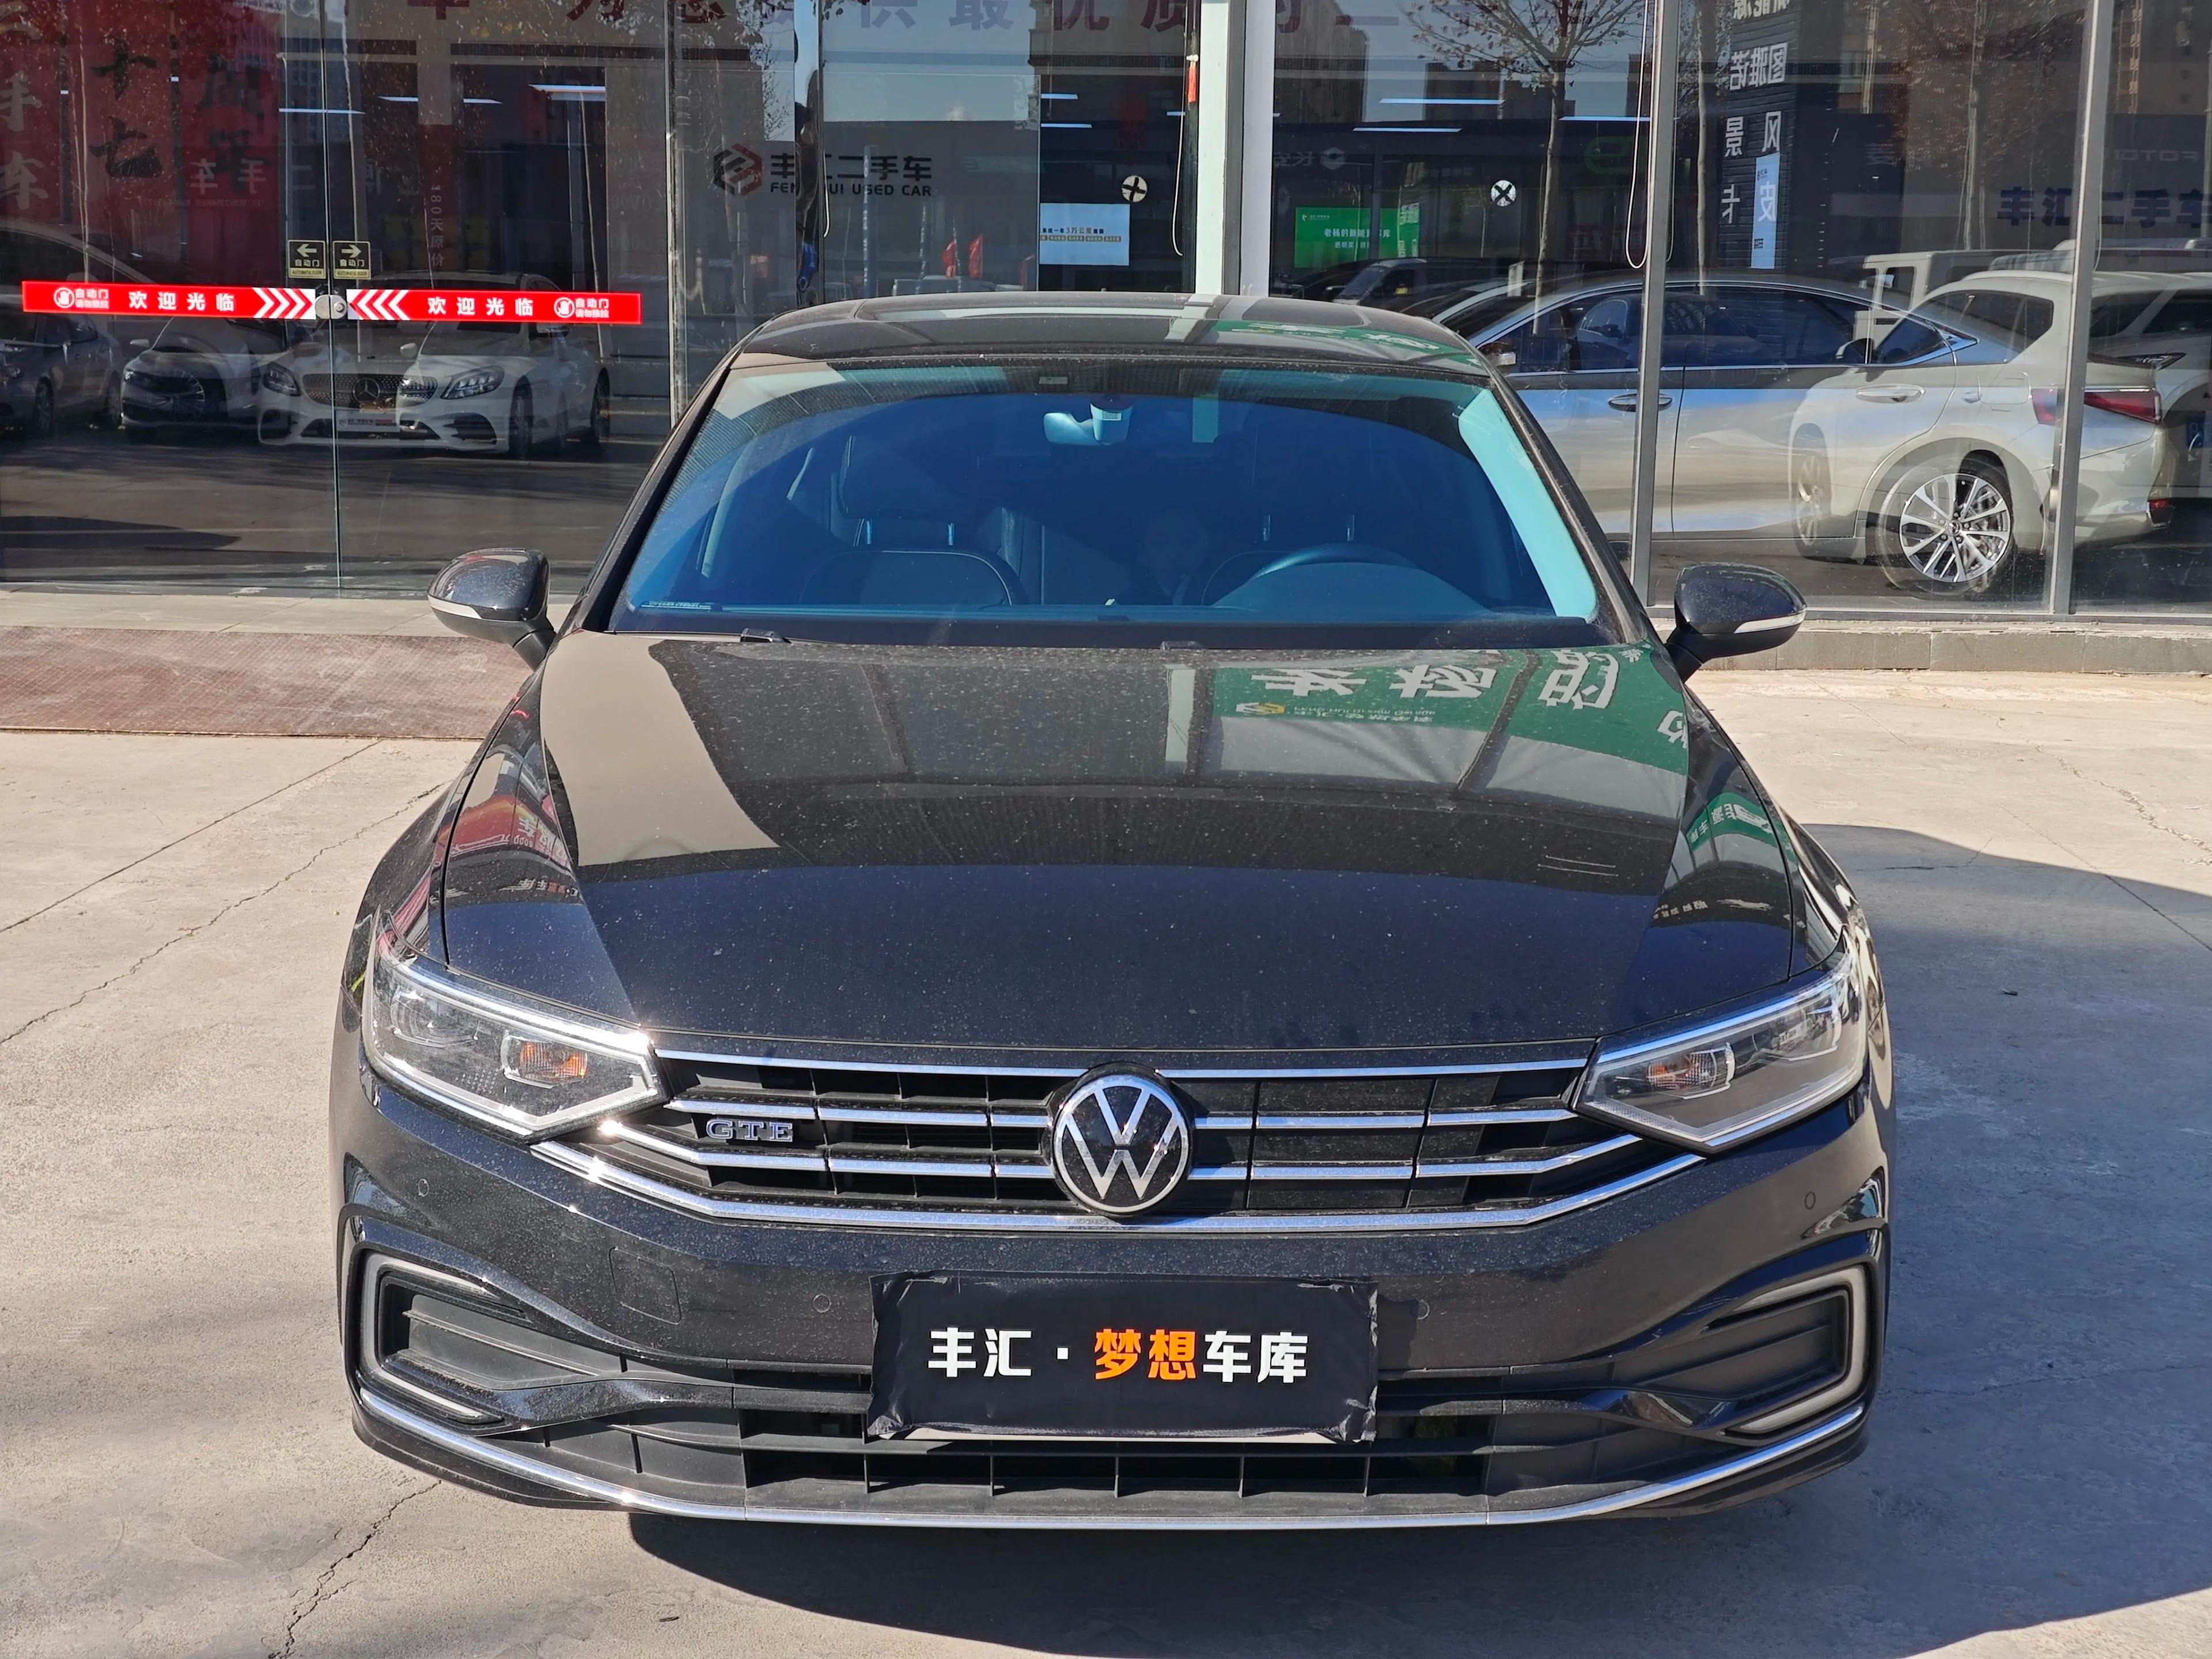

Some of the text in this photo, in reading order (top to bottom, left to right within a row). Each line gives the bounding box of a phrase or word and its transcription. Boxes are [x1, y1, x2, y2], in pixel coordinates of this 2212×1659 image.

[853, 184, 894, 195] USED
[902, 184, 932, 196] CAR
[295, 259, 320, 267] 自动门
[340, 259, 365, 267] 自动门
[75, 288, 109, 299] 自动门
[128, 290, 235, 312] 欢迎光临
[427, 297, 533, 316] 欢迎光临
[575, 298, 609, 308] 自动门
[705, 1119, 794, 1143] GTE
